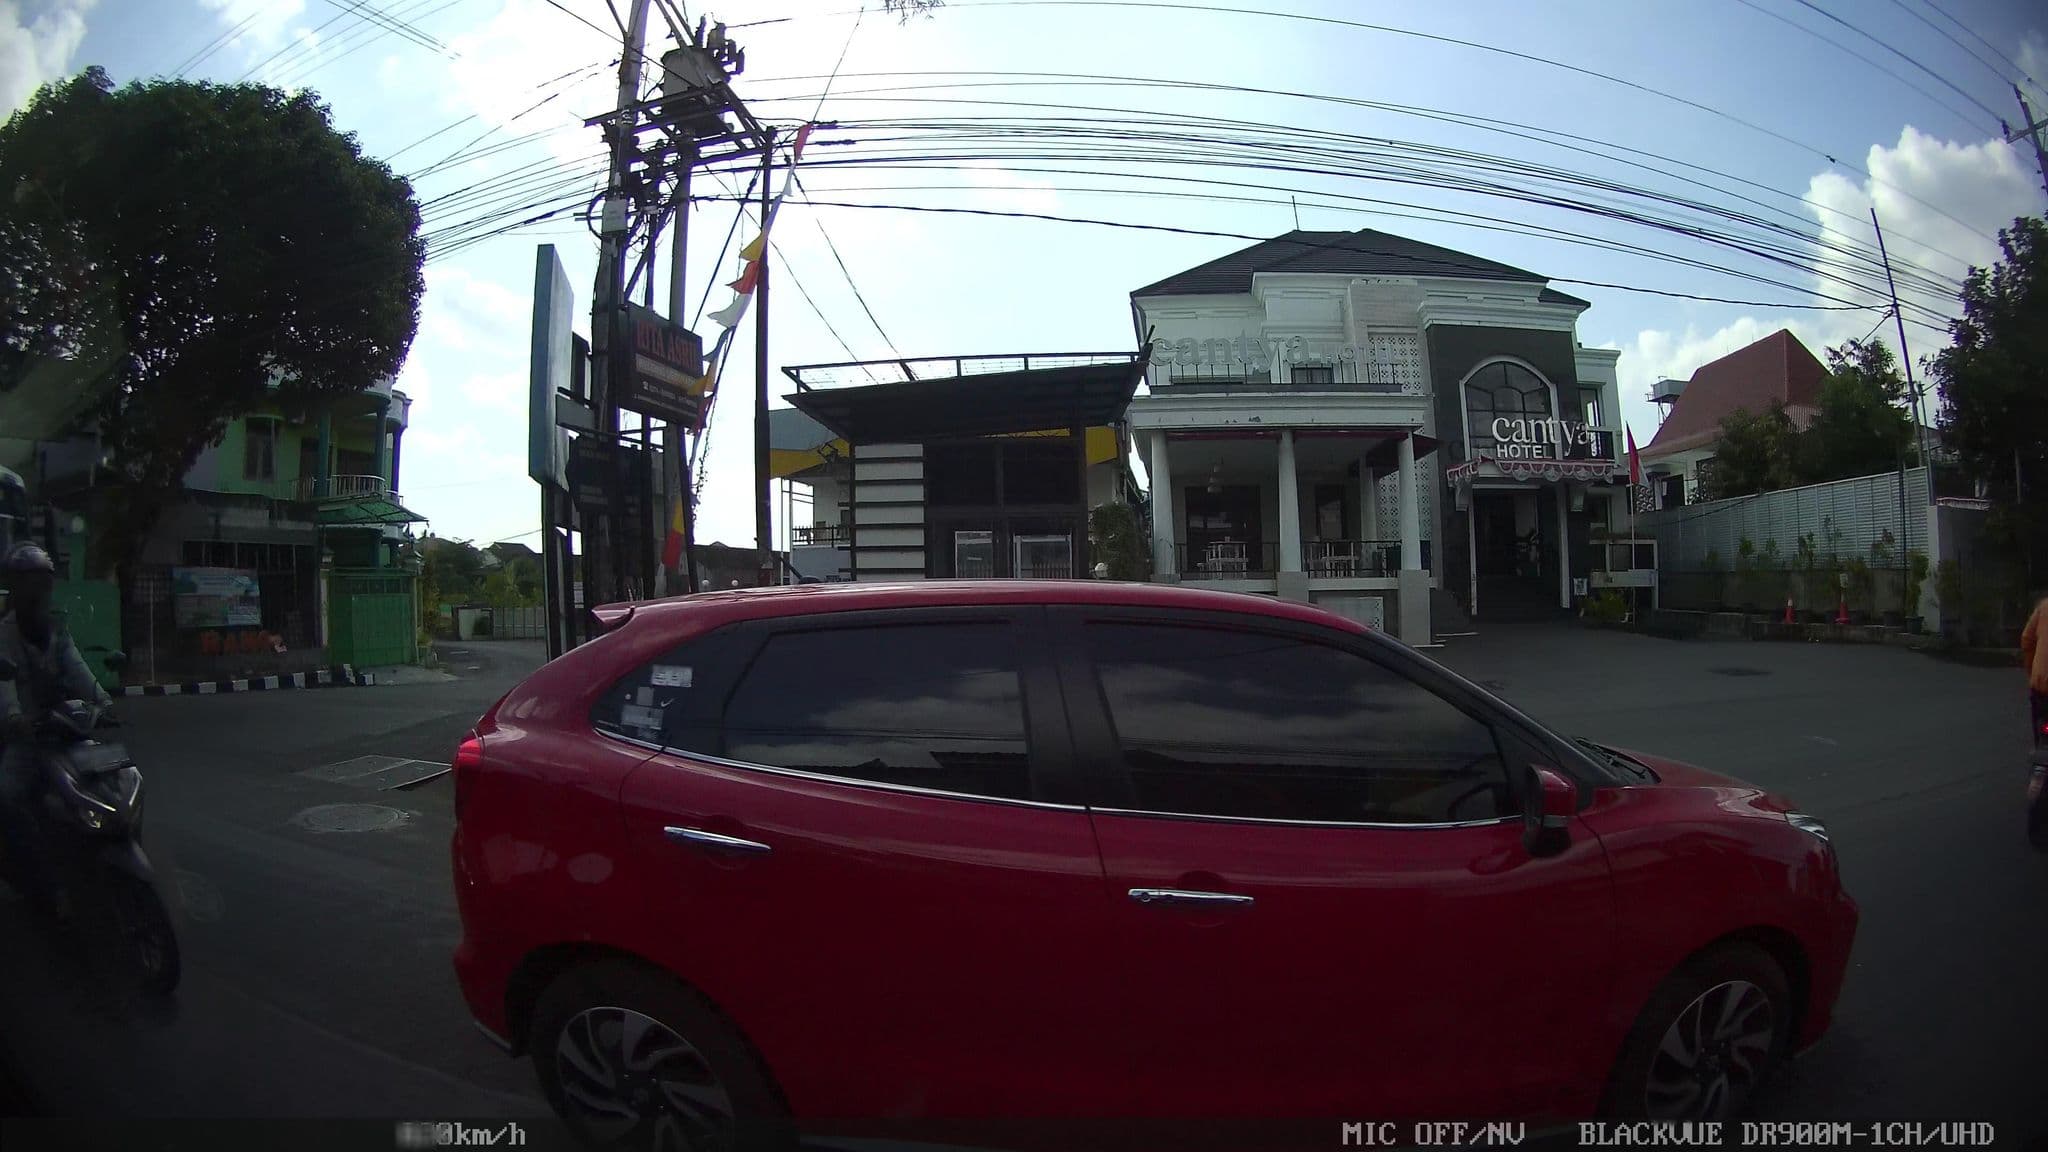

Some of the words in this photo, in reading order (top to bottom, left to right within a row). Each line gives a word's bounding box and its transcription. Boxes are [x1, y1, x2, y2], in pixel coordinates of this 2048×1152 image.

[1150, 330, 1309, 374] cantya
[1492, 416, 1591, 457] cantya
[1497, 444, 1553, 459] HOTEL
